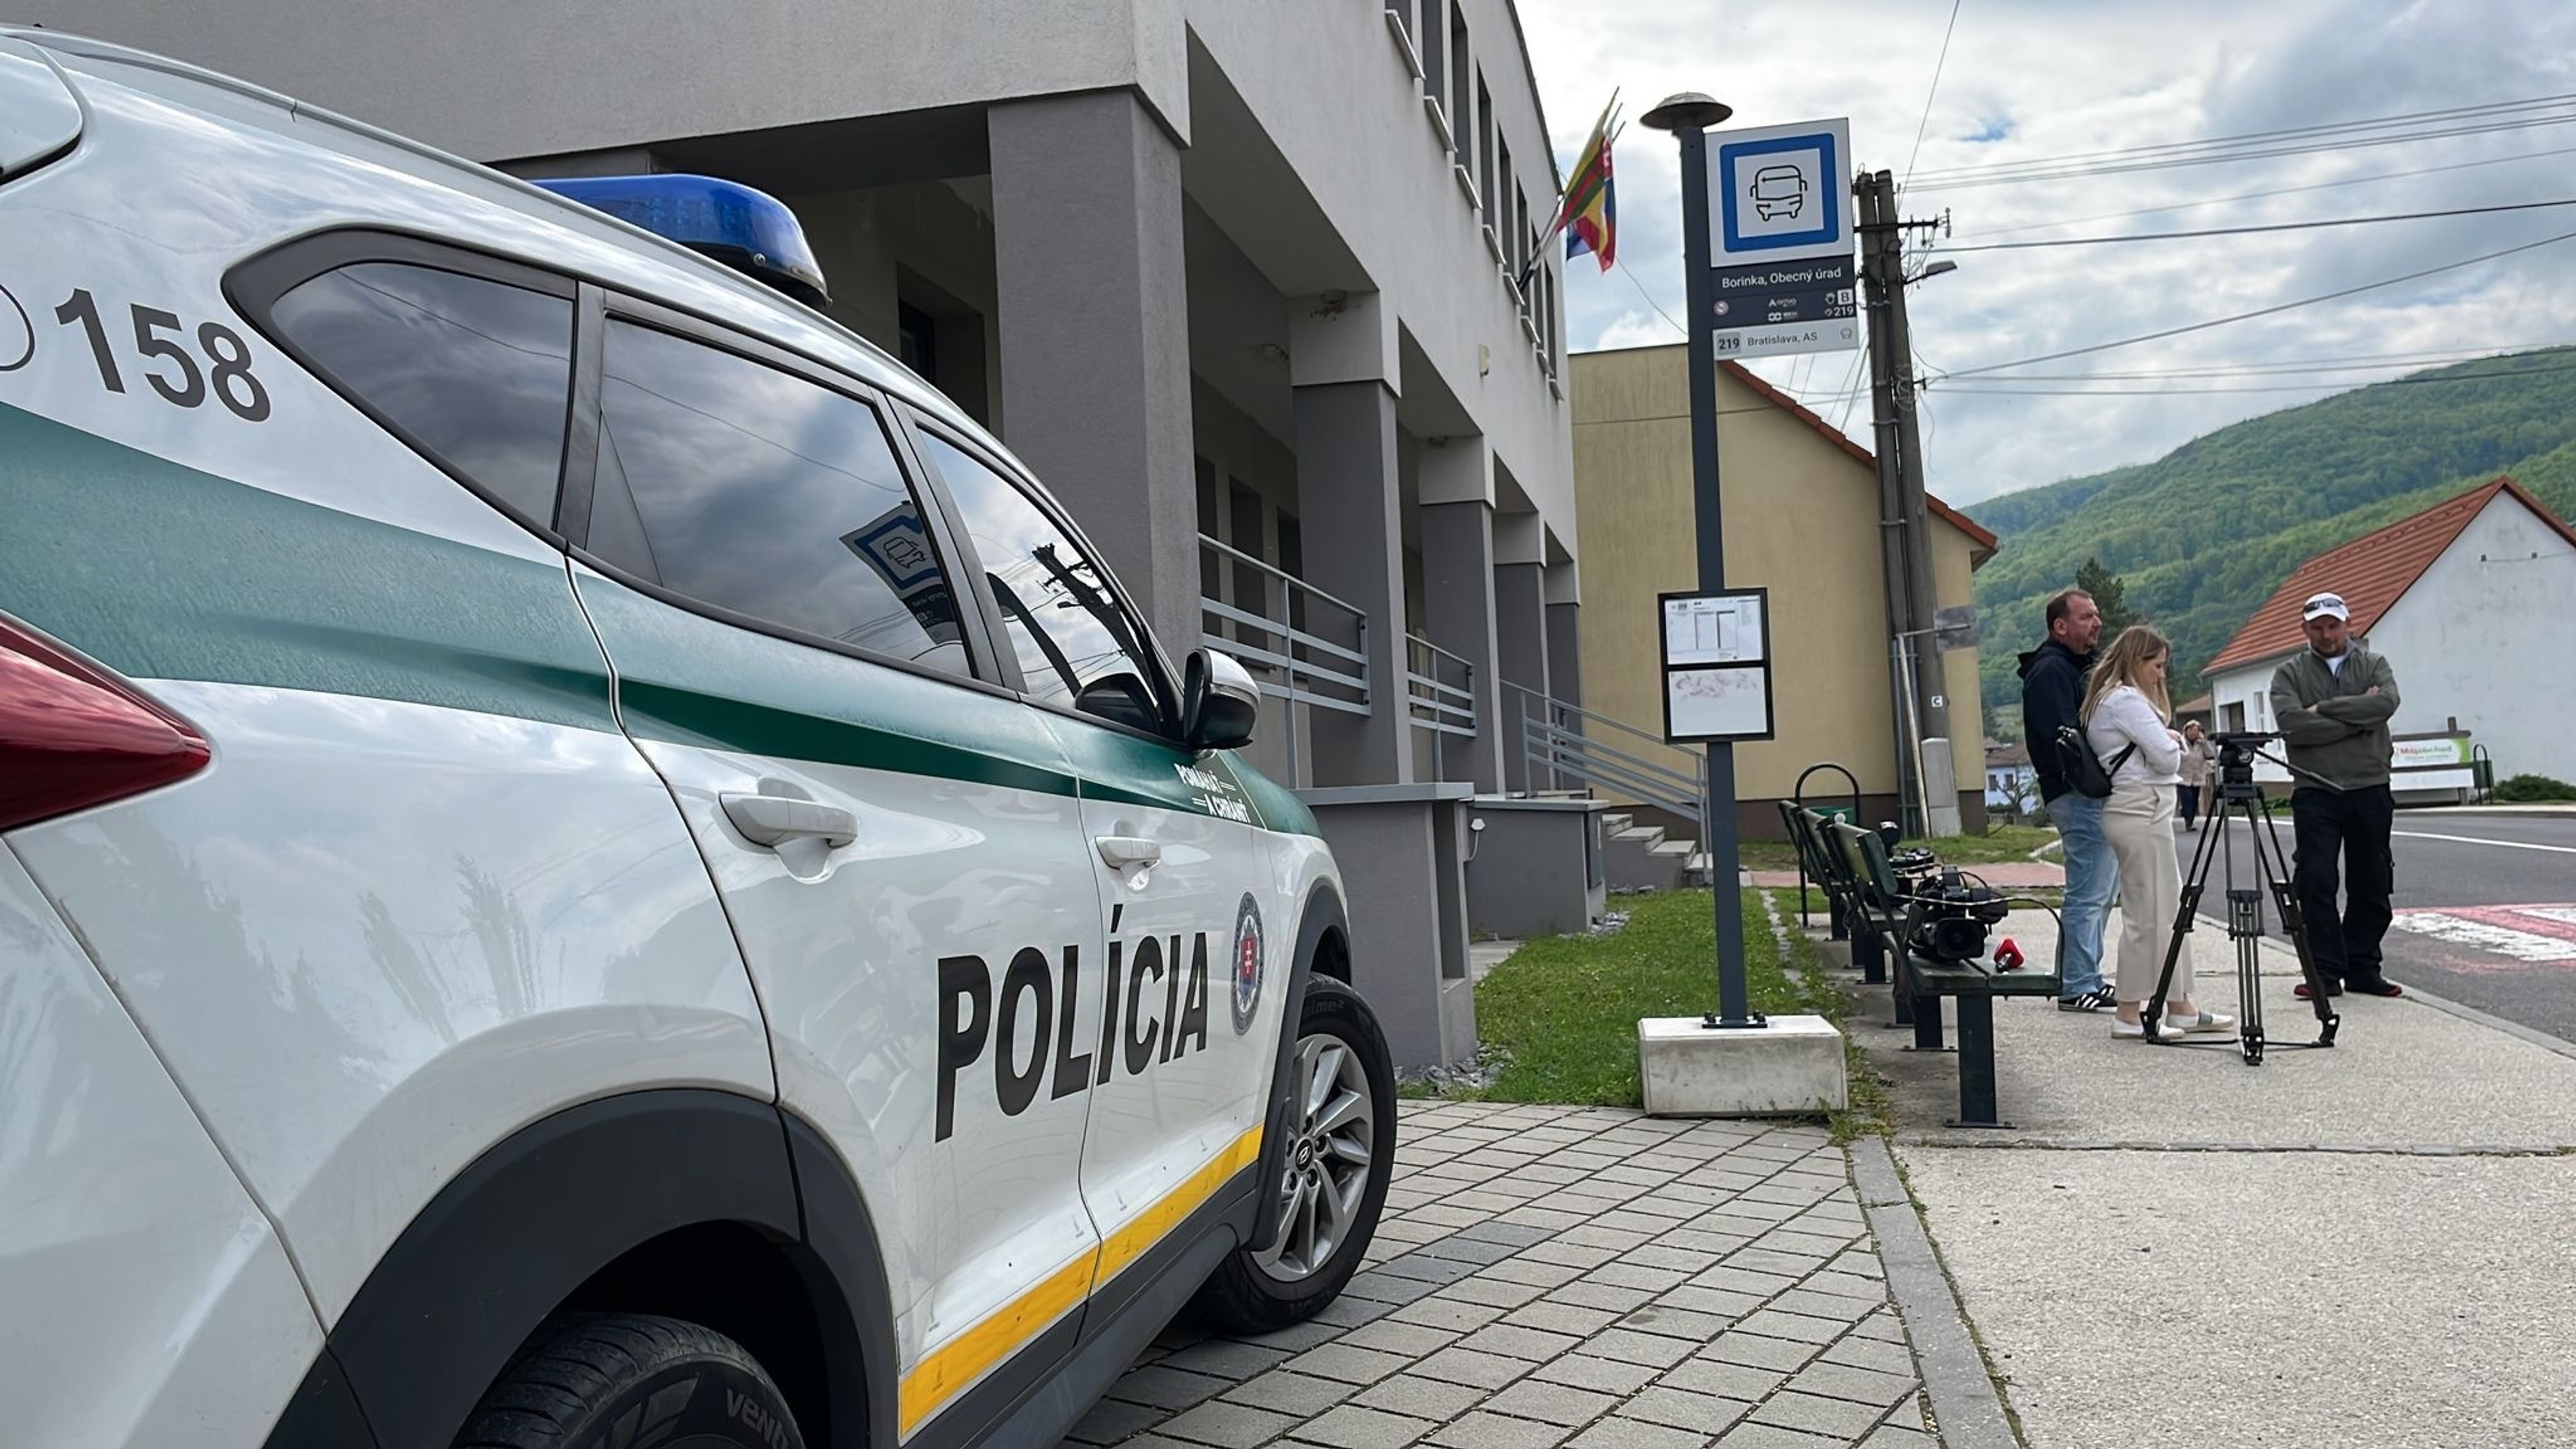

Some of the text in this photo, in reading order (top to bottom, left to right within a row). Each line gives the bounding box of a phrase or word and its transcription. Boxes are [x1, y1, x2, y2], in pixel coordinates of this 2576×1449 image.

[1722, 266, 1842, 288] Borinka, Obecný úrad
[1842, 292, 1849, 302] B
[1834, 306, 1854, 316] 219
[1719, 332, 1817, 349] 219 Bratislava, AS
[54, 288, 271, 422] 158
[935, 903, 1208, 1143] POLÍCIA
